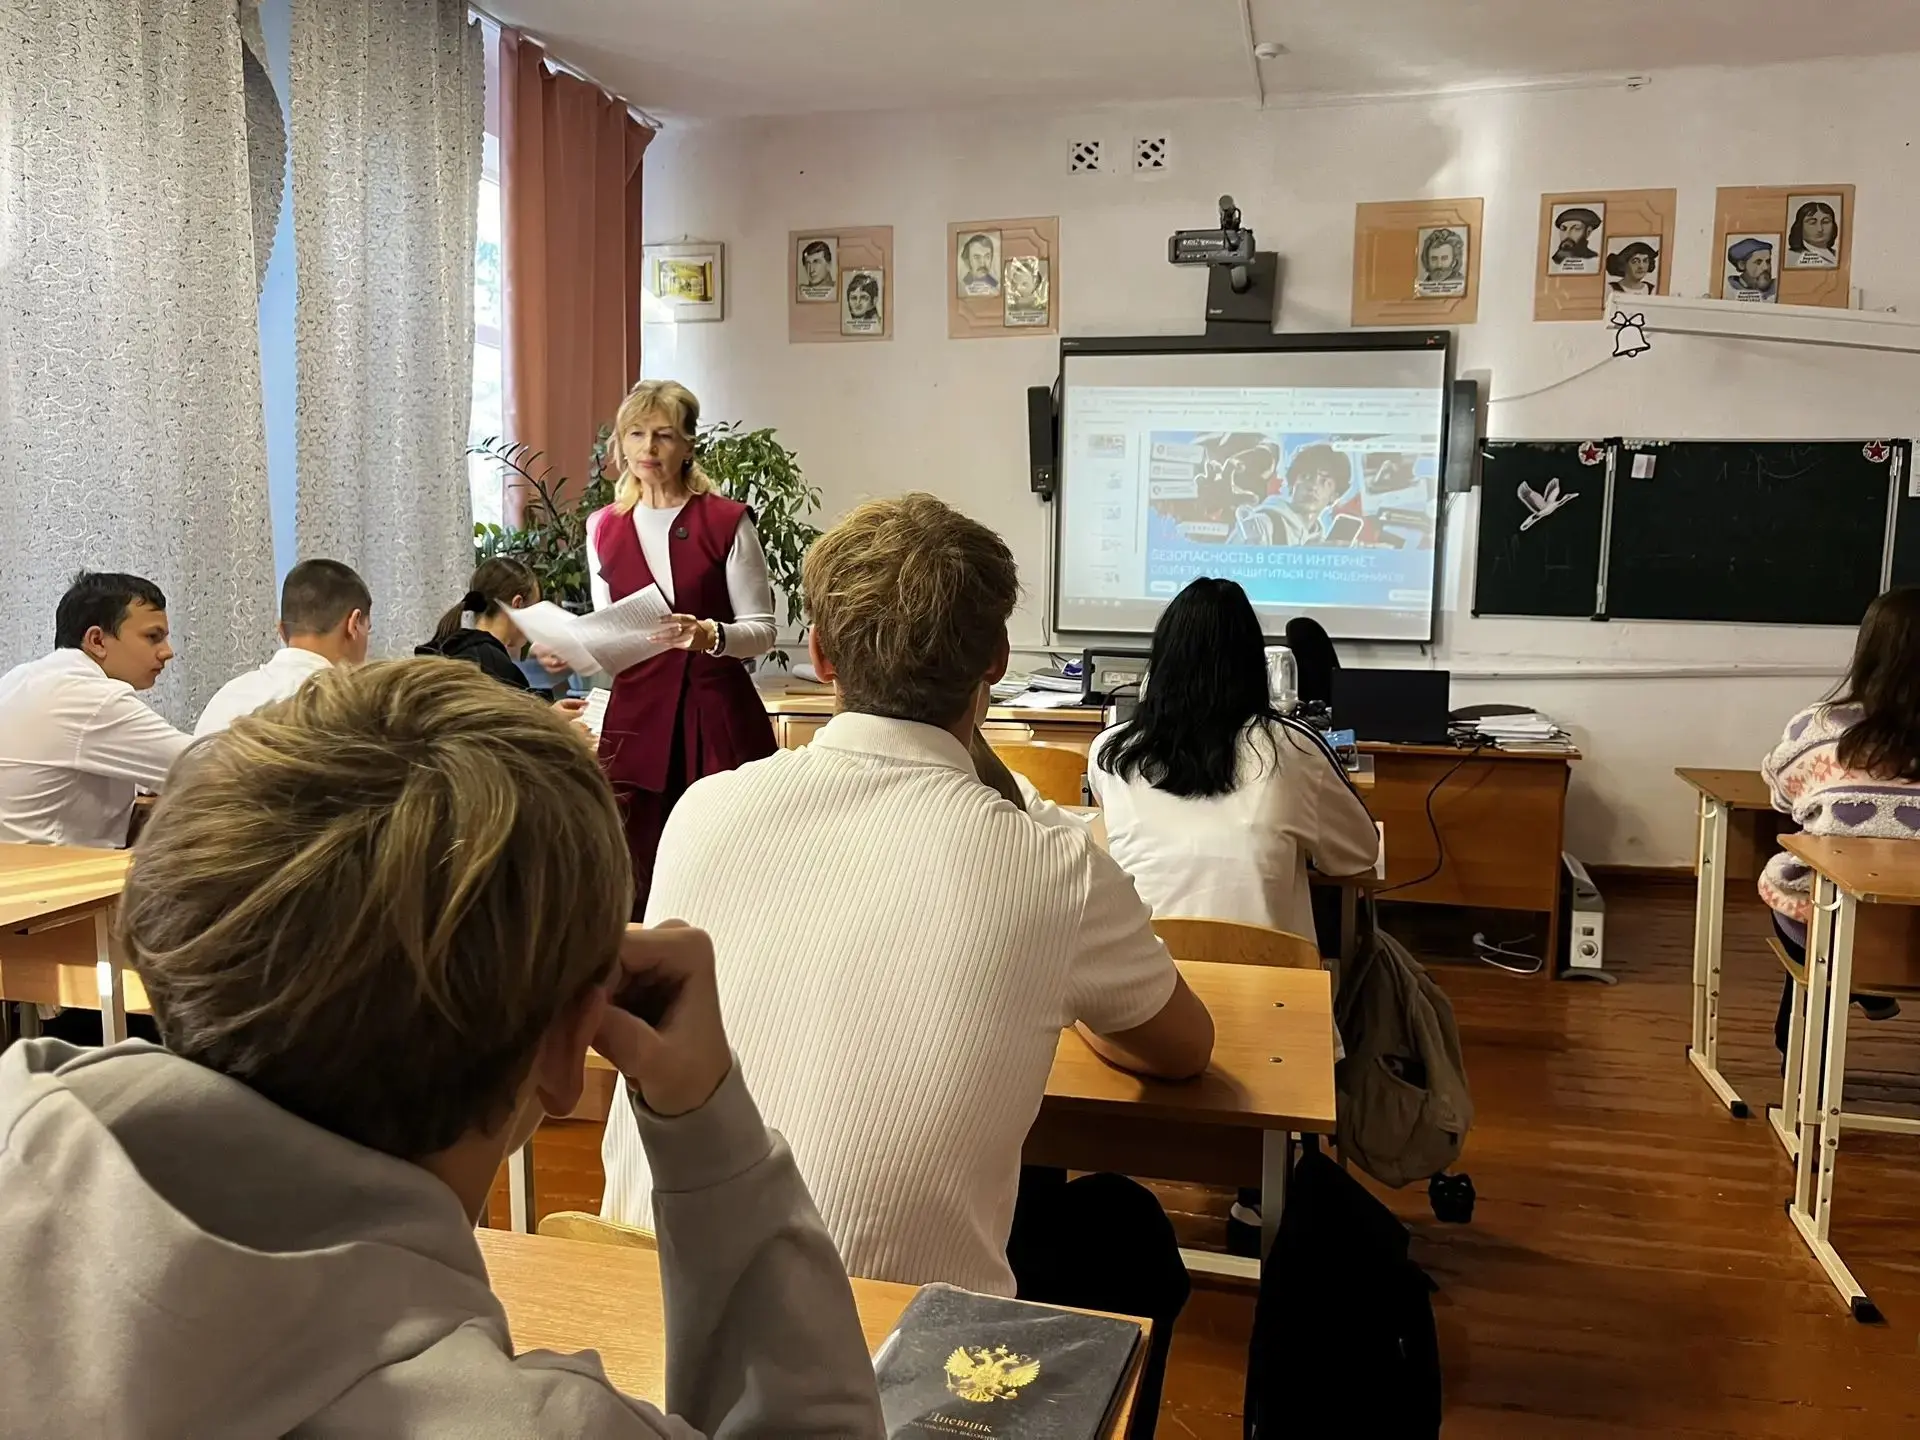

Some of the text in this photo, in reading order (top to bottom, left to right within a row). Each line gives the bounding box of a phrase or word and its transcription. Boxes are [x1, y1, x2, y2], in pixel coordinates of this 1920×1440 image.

[1151, 549, 1253, 564] БЕЗОПАСНОСТЬ
[1256, 552, 1265, 564] В
[1268, 552, 1303, 566] СЕТИ
